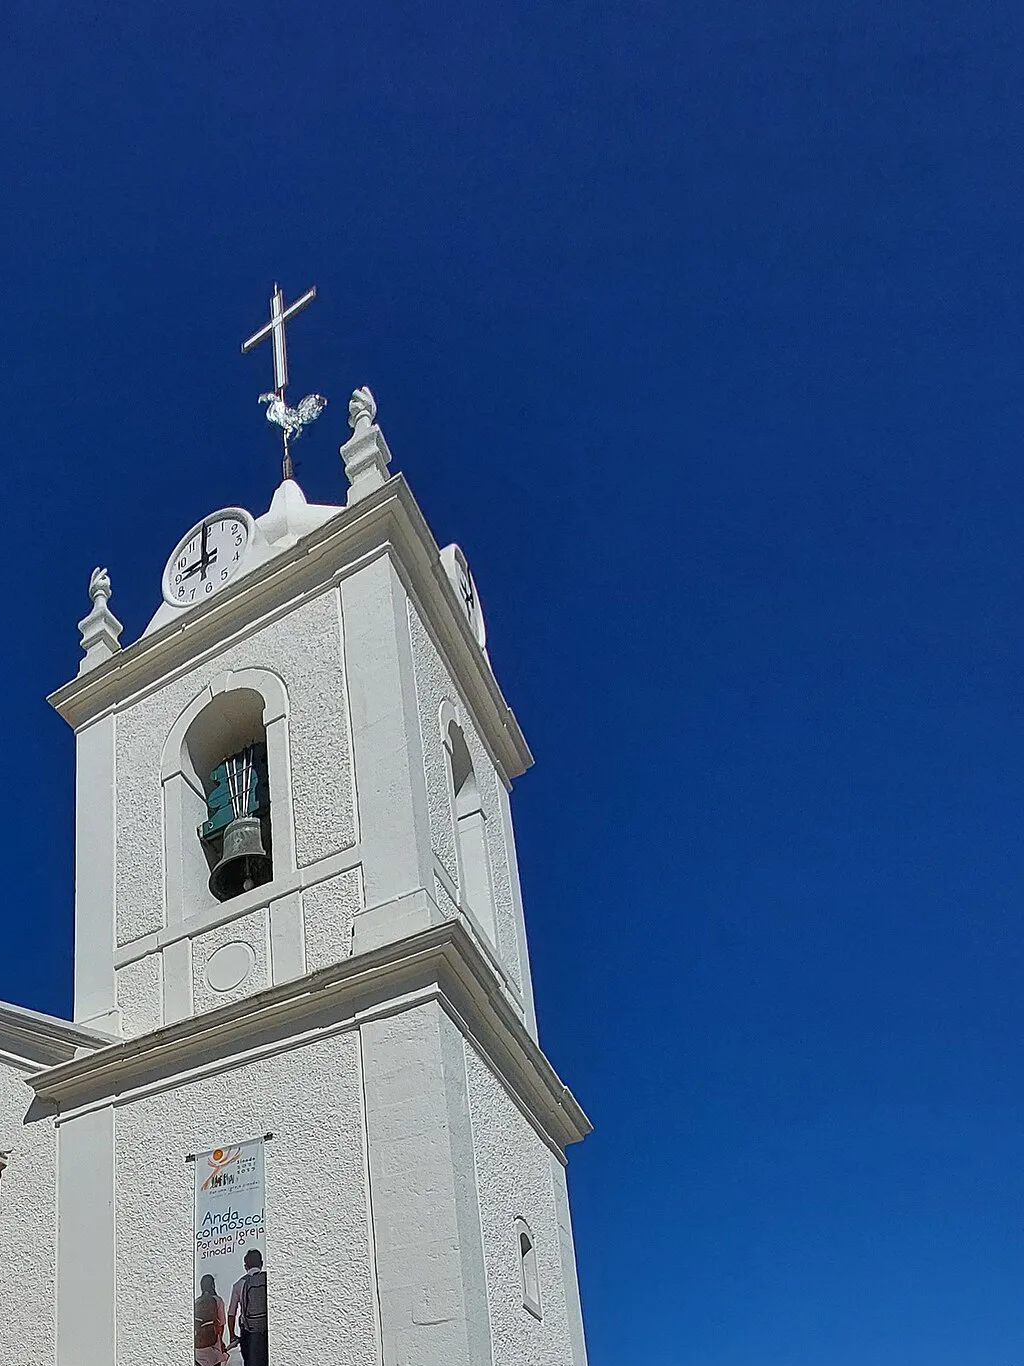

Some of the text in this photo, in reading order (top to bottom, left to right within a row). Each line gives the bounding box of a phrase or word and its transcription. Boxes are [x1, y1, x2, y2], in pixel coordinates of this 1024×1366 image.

[221, 522, 224, 531] 1
[231, 523, 238, 536] 2
[235, 534, 242, 546] 3
[189, 541, 195, 553] 11
[233, 551, 240, 561] 4
[178, 557, 187, 570] 10
[175, 574, 183, 585] 9
[221, 568, 228, 580] 5
[178, 586, 185, 597] 8
[205, 581, 213, 593] 6
[189, 587, 196, 600] 7
[201, 1206, 239, 1226] Anda
[196, 1208, 264, 1240] connosco!
[196, 1224, 265, 1252] Por uma Igreja
[201, 1242, 235, 1260] sinodal
